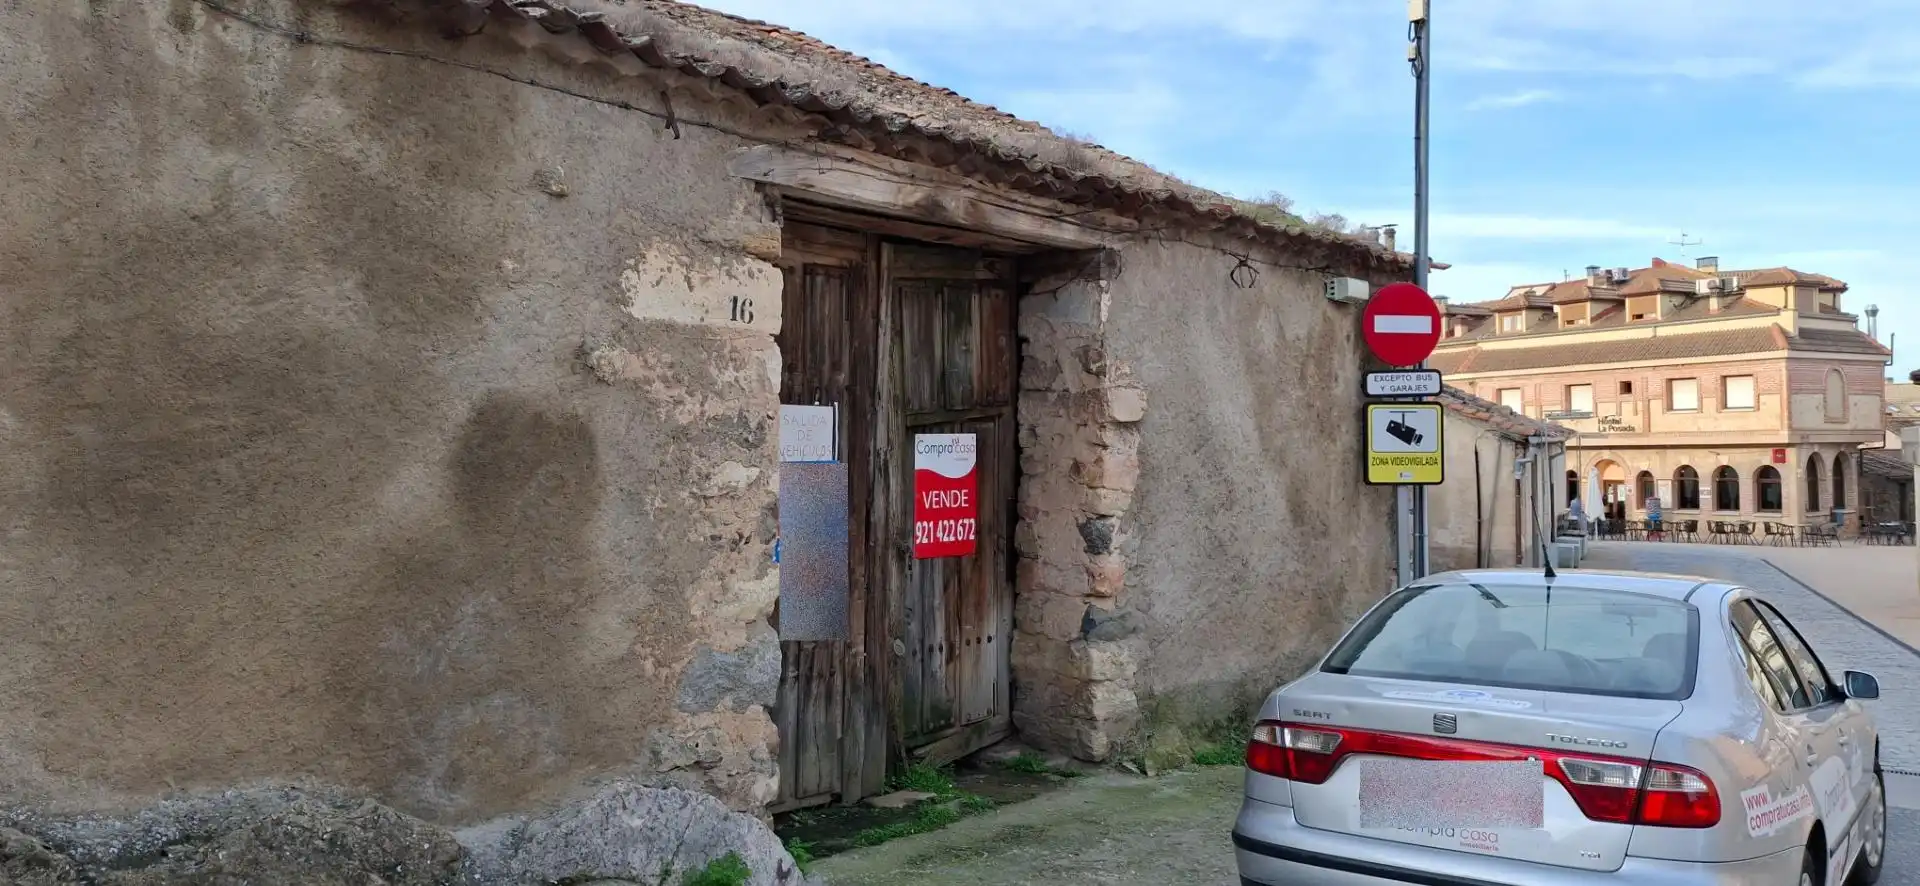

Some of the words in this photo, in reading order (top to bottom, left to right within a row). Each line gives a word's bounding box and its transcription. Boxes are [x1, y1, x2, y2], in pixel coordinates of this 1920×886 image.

[730, 295, 754, 324] 16
[1373, 374, 1412, 382] EXCEPTO
[1390, 384, 1428, 393] GARAJES
[783, 414, 827, 427] SALIDA
[1598, 424, 1607, 432] La
[1608, 424, 1636, 432] Posada
[797, 428, 813, 442] DE
[1371, 456, 1389, 466] ZONA
[1390, 456, 1439, 466] VIDEOVIGILADA
[922, 490, 969, 509] VENDE
[916, 521, 935, 545] 921
[936, 519, 956, 543] 422
[957, 517, 976, 541] 672
[1293, 708, 1332, 720] SEAT
[1546, 733, 1628, 749] TOLEDO
[1460, 828, 1499, 844] casa
